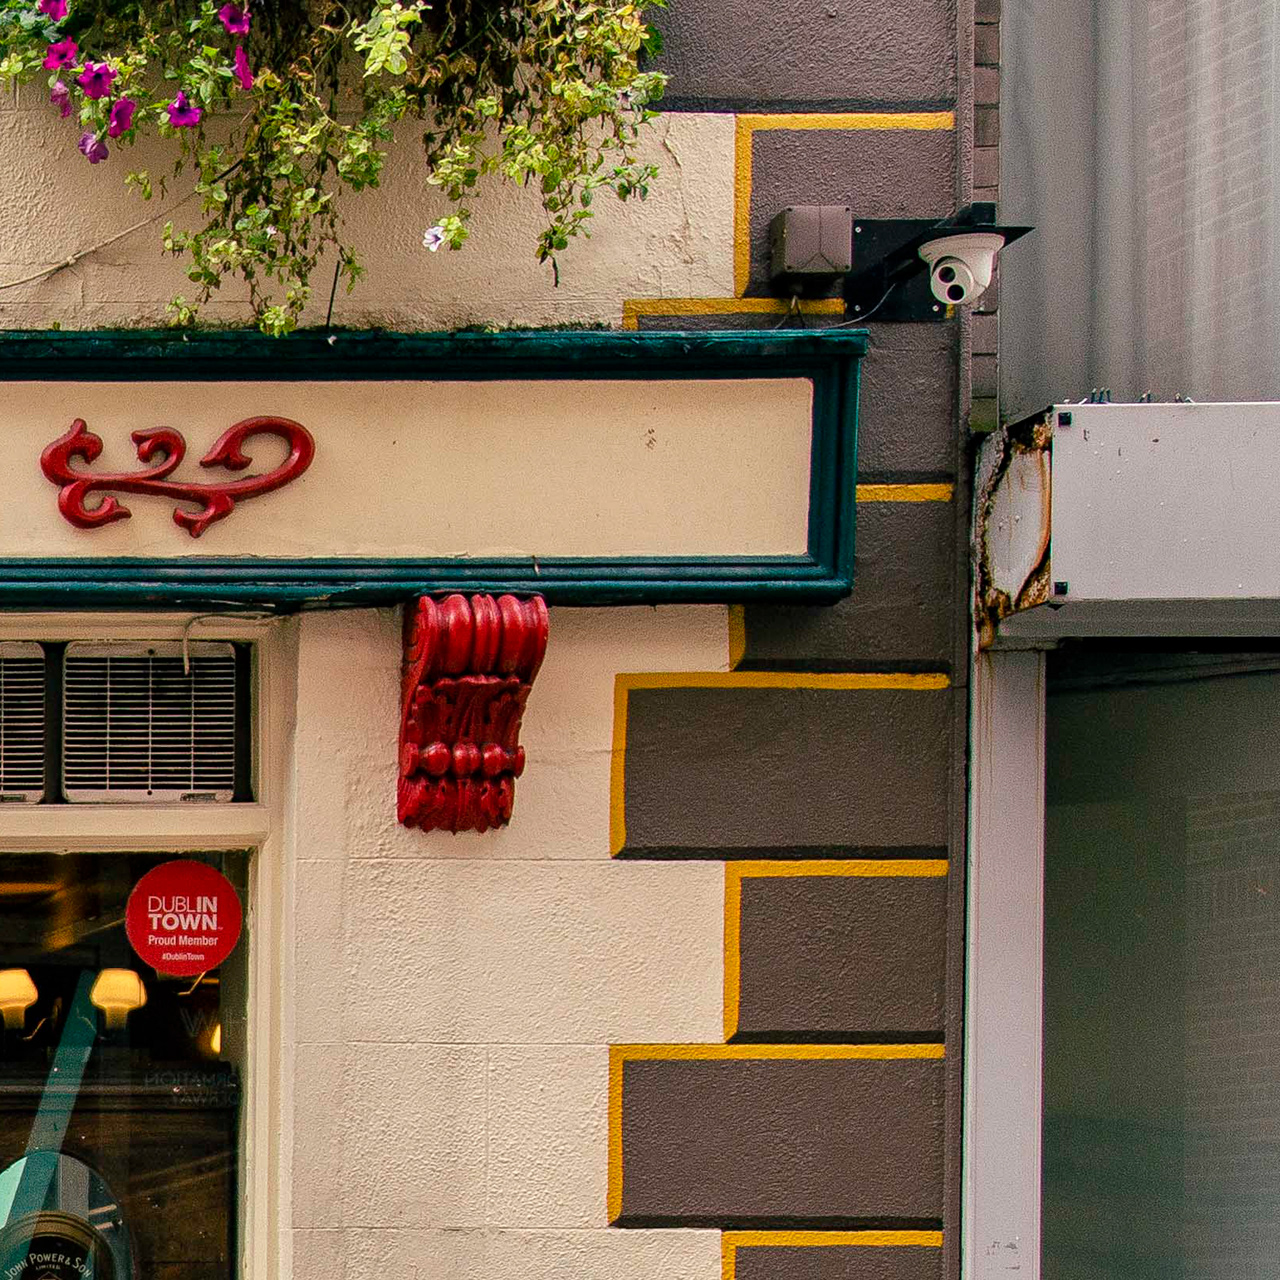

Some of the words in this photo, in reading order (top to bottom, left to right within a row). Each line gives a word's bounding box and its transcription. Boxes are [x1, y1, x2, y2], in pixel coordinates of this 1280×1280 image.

[148, 896, 218, 912] DUBLIN
[148, 913, 218, 931] TOWN
[148, 935, 177, 946] Proud
[178, 935, 218, 946] Member
[162, 953, 205, 961] #DublinTown
[4, 1259, 28, 1280] JOHN
[29, 1253, 64, 1264] POWER
[72, 1257, 92, 1277] SON
